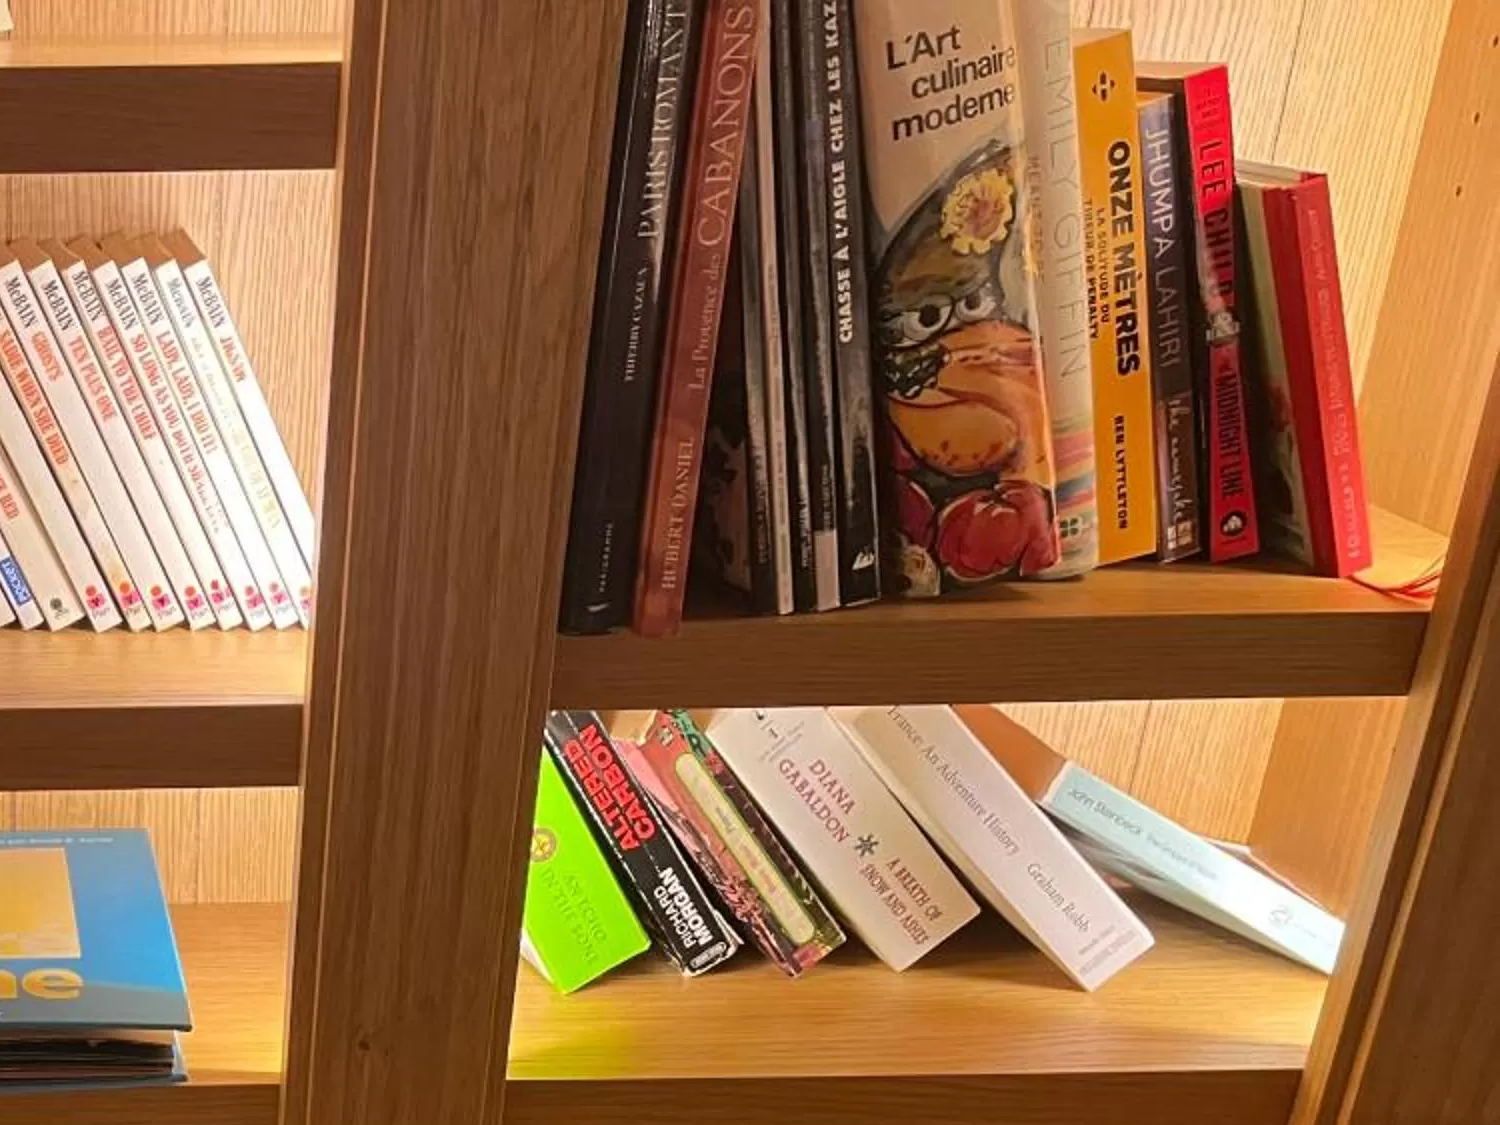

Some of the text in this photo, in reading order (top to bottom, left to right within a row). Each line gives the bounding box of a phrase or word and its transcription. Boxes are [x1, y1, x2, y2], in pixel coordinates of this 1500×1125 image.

[826, 56, 840, 90] LES
[886, 25, 961, 70] L'Art
[911, 44, 1015, 98] culinaire
[696, 3, 756, 248] CABANONS
[829, 99, 843, 152] CHEZ
[892, 84, 1015, 141] moderne
[635, 150, 670, 239] PARIS
[829, 159, 848, 238] L'AIGLE
[1041, 38, 1091, 376] EMILY GIFFIN
[1197, 139, 1228, 198] LEE
[831, 245, 849, 260] À
[1083, 197, 1099, 338] TIREUR DE PENALTY
[1096, 207, 1108, 322] LA SOLITUDE DU
[1105, 140, 1149, 376] ONZE MÈTRES
[1144, 128, 1183, 367] JHUMPA LAHIRI
[1203, 207, 1237, 297] CHILD
[4, 275, 64, 381] McBAIN GHOSTS
[106, 277, 140, 331] McBAIN
[129, 332, 149, 353] SO
[198, 275, 228, 328] McBAIN
[687, 252, 722, 390] La Provence des
[835, 267, 854, 343] CHASSE
[42, 279, 119, 422] McBAIN TEN PLUS ONE
[71, 270, 159, 442] McBAIN HAIL TO THE CHIEF
[133, 272, 166, 326] McBAIN
[189, 408, 212, 435] DID
[136, 350, 164, 388] LONG
[12, 366, 43, 408] WHEN
[31, 406, 56, 435] SHE
[44, 432, 71, 466] DIED
[152, 385, 172, 406] AS
[159, 402, 182, 430] YOU
[1216, 371, 1244, 497] MIDNIGHT LINE
[660, 436, 695, 589] HUBERT DANIEL
[1115, 415, 1128, 528] BEN LYTTLETON
[0, 558, 28, 602] POCKET
[560, 735, 640, 854] ALTERED
[576, 722, 658, 843] CARBON
[775, 756, 851, 844] GABALDON
[807, 757, 858, 815] DIANA
[920, 742, 943, 765] An
[934, 759, 988, 816] Adventure
[980, 811, 1024, 856] History
[651, 883, 697, 950] RICHARD
[655, 864, 715, 946] MORGAN
[859, 861, 892, 897] SNOW
[882, 890, 908, 918] AND
[885, 855, 943, 922] A BREATH OF
[1022, 858, 1094, 935] Graham Robb
